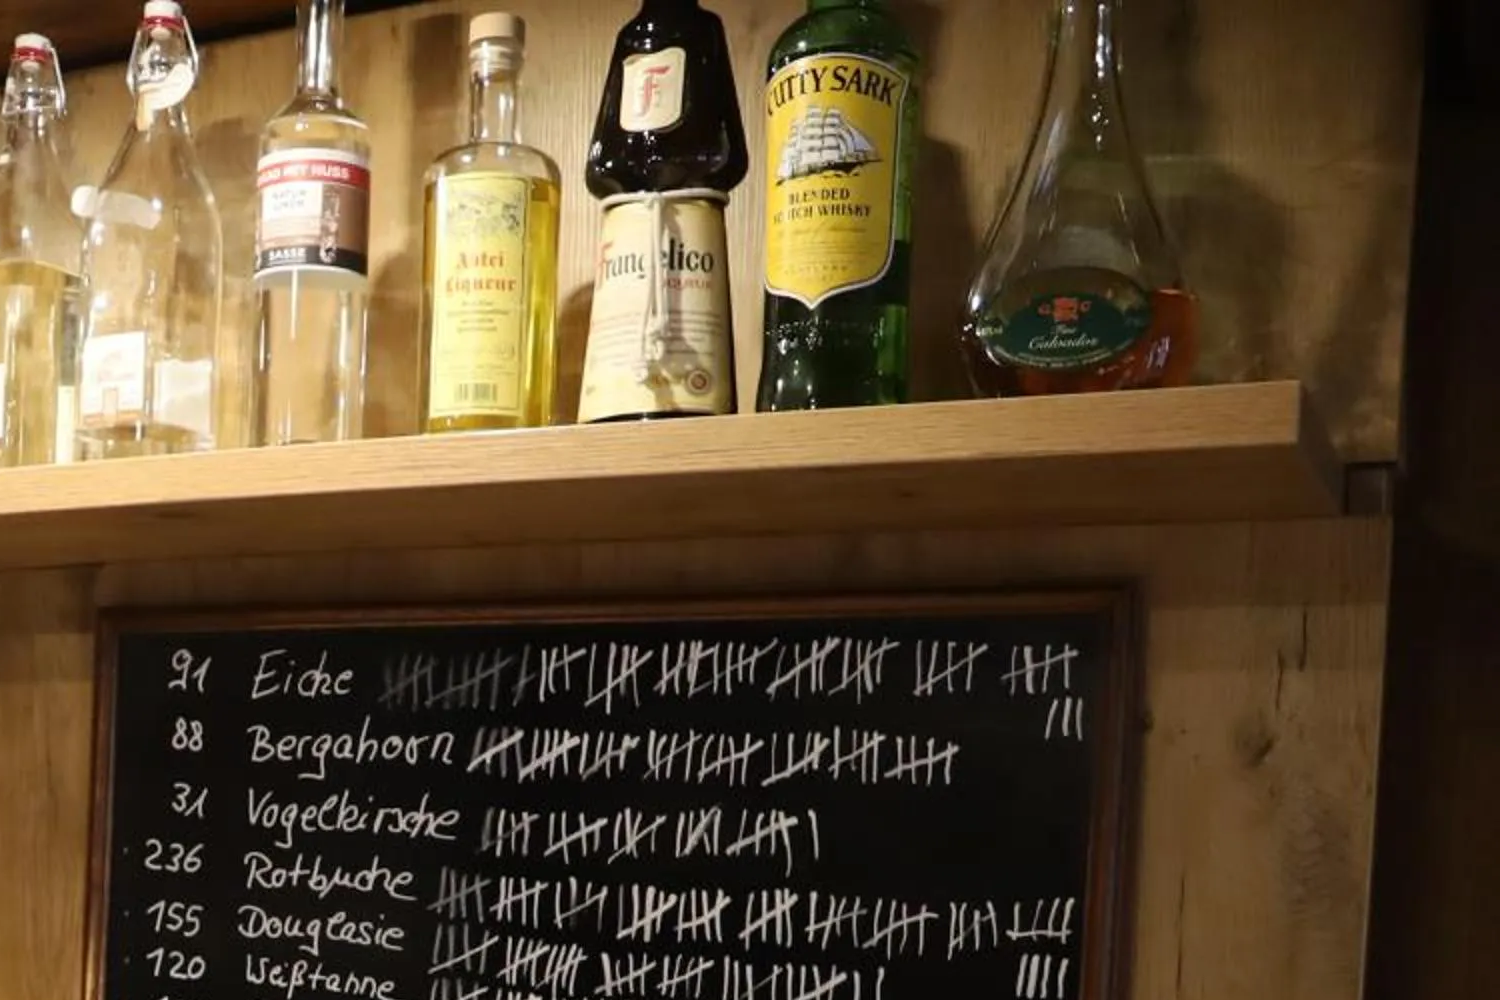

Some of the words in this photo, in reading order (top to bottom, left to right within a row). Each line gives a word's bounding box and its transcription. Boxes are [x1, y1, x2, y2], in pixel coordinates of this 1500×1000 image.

[766, 67, 828, 116] CUTTY
[830, 65, 898, 107] SARK
[773, 205, 813, 224] SCTCH
[817, 203, 872, 218] WHISKY
[788, 187, 850, 205] BLENDED
[167, 647, 212, 692] 91
[251, 648, 354, 699] Eiche
[171, 717, 204, 751] 88
[246, 715, 455, 779] Bergahorn
[171, 782, 208, 818] 31
[248, 789, 461, 848] Vogelkirsche
[144, 838, 204, 872] 236
[244, 851, 418, 900] Rotbuche
[146, 900, 204, 937] 155
[238, 904, 405, 956] Douglasie
[146, 947, 207, 981] 120
